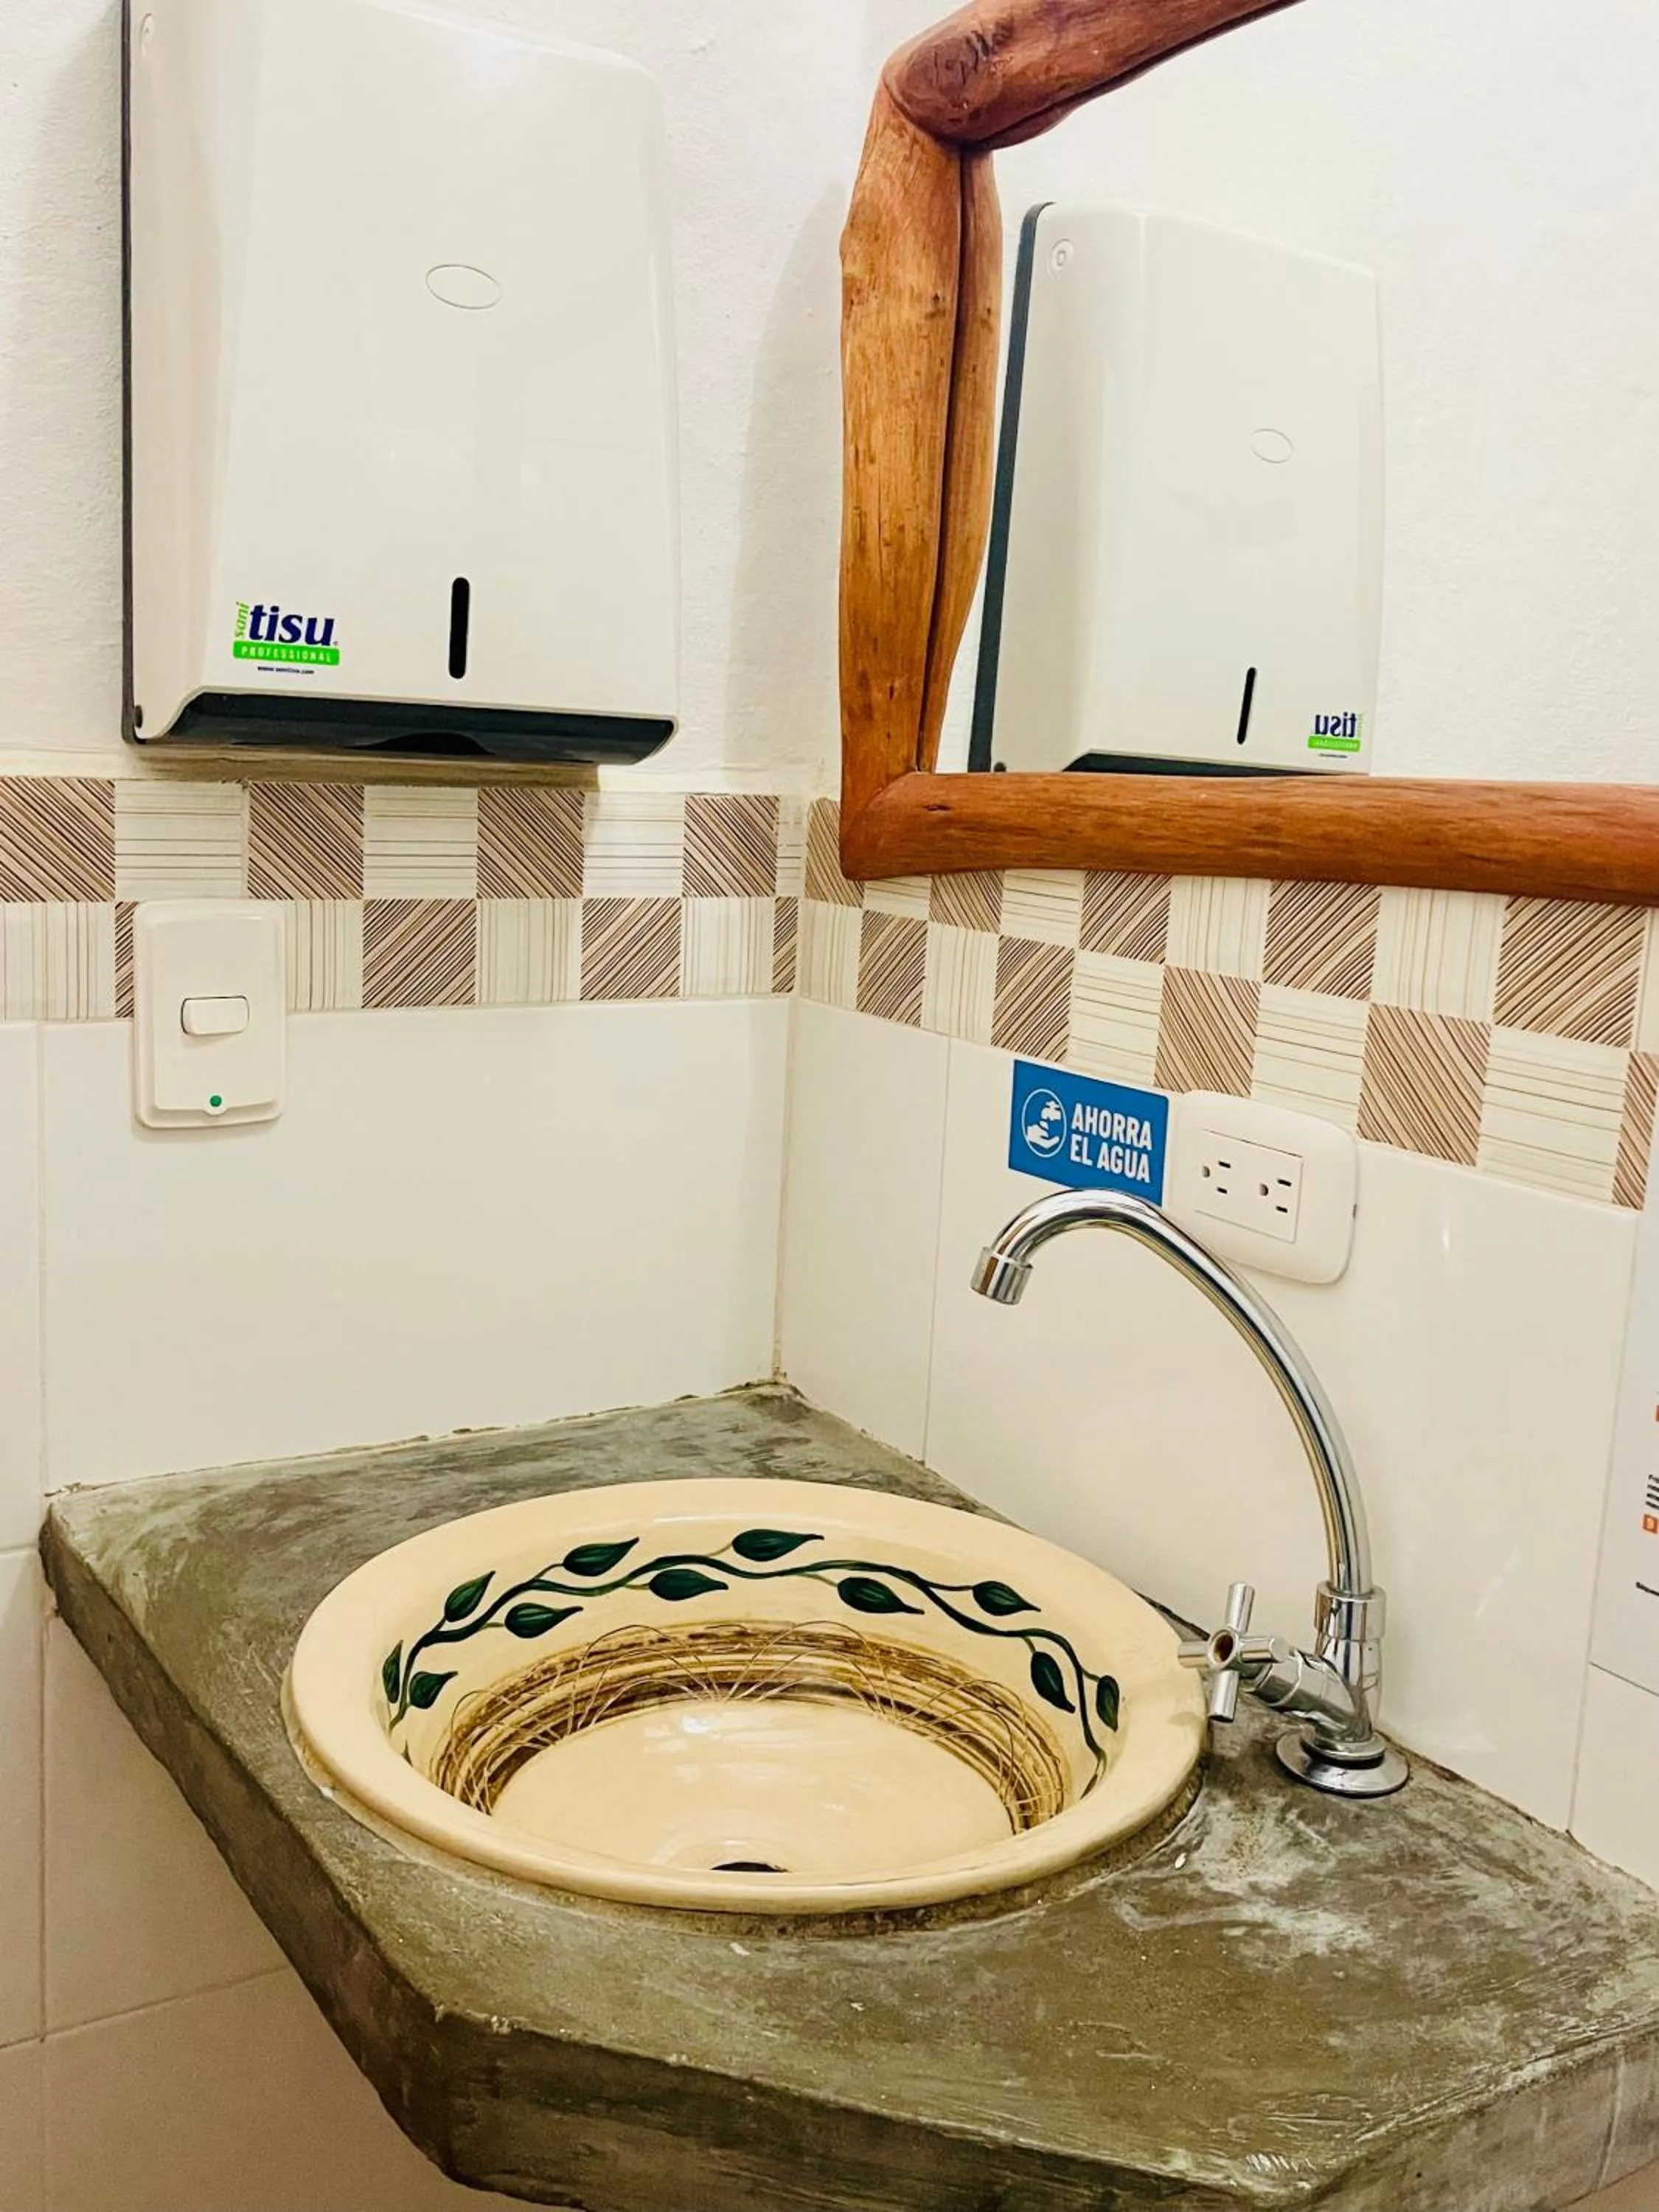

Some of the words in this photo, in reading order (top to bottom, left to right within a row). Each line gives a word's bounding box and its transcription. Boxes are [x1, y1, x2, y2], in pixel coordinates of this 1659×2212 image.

[234, 602, 249, 637] sani
[248, 605, 335, 646] tisu
[241, 645, 331, 662] PROFESSIONAL
[1071, 1103, 1152, 1150] AHORRA
[1070, 1134, 1093, 1166] EL
[1097, 1142, 1150, 1183] AGUA
